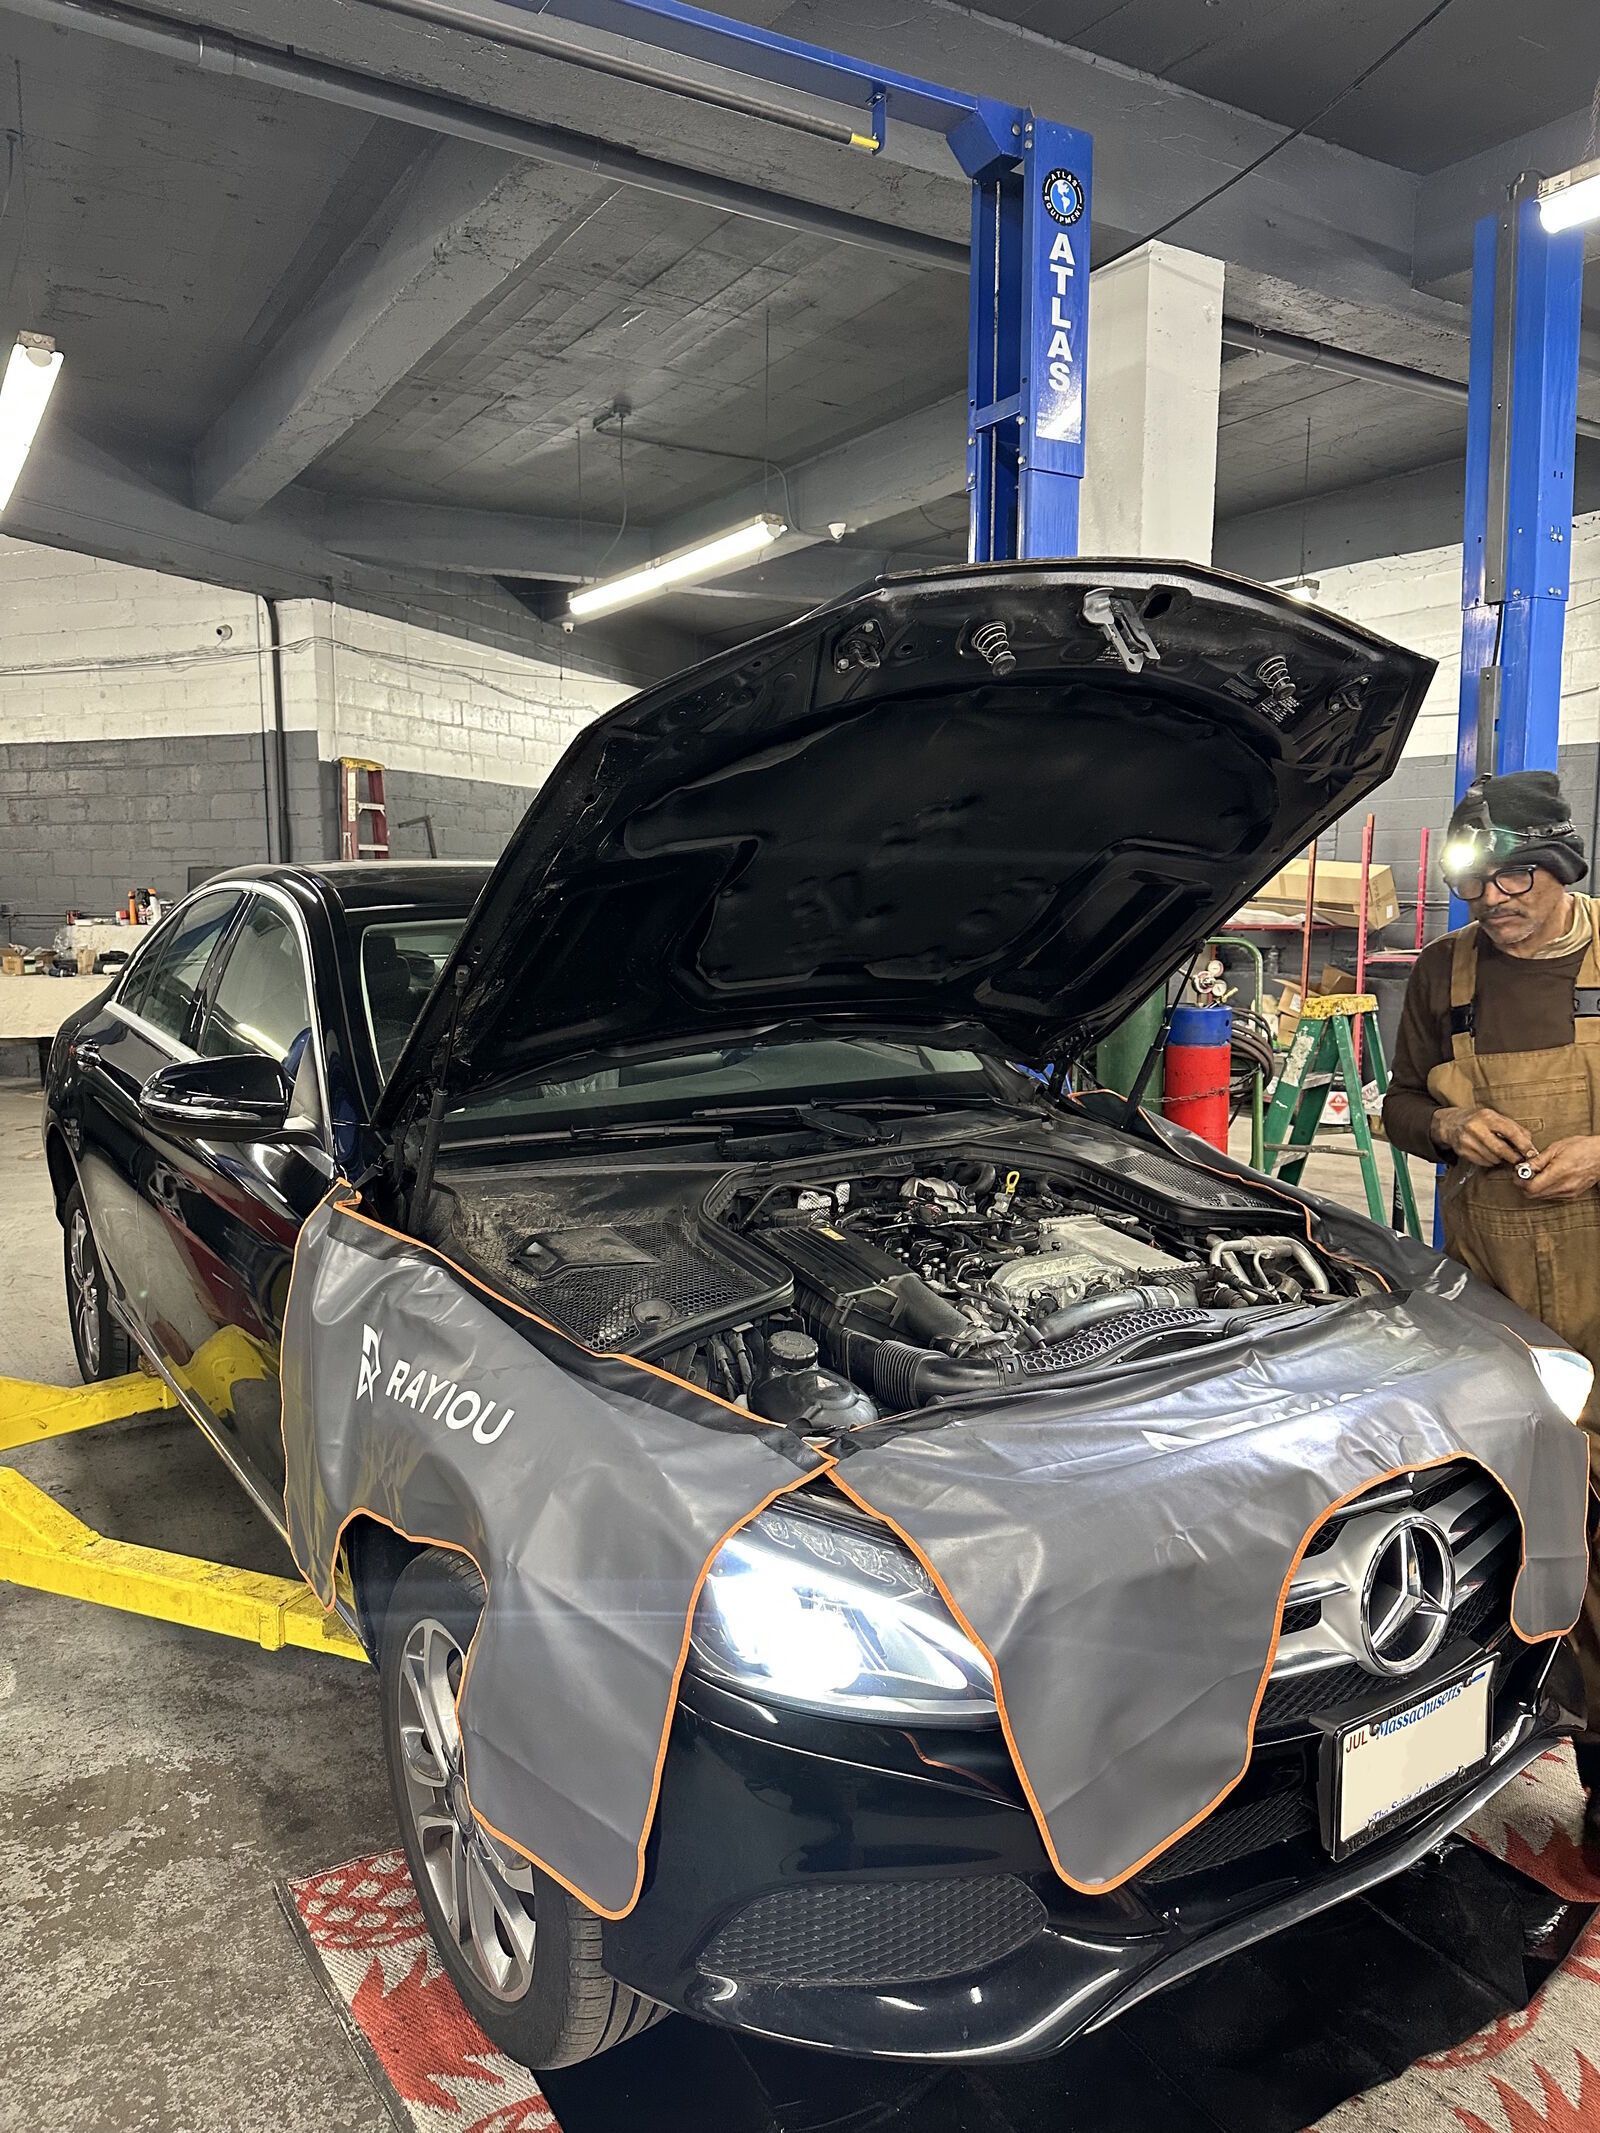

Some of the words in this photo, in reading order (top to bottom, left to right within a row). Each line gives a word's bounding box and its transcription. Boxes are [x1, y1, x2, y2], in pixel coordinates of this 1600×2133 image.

[1051, 171, 1078, 187] ATLAS
[1044, 195, 1082, 224] EQUIPMENT
[1047, 232, 1076, 392] ATLAS
[385, 1359, 516, 1445] RAYIOU
[1376, 1684, 1463, 1740] Massachusetts
[1346, 1730, 1368, 1753] JUL
